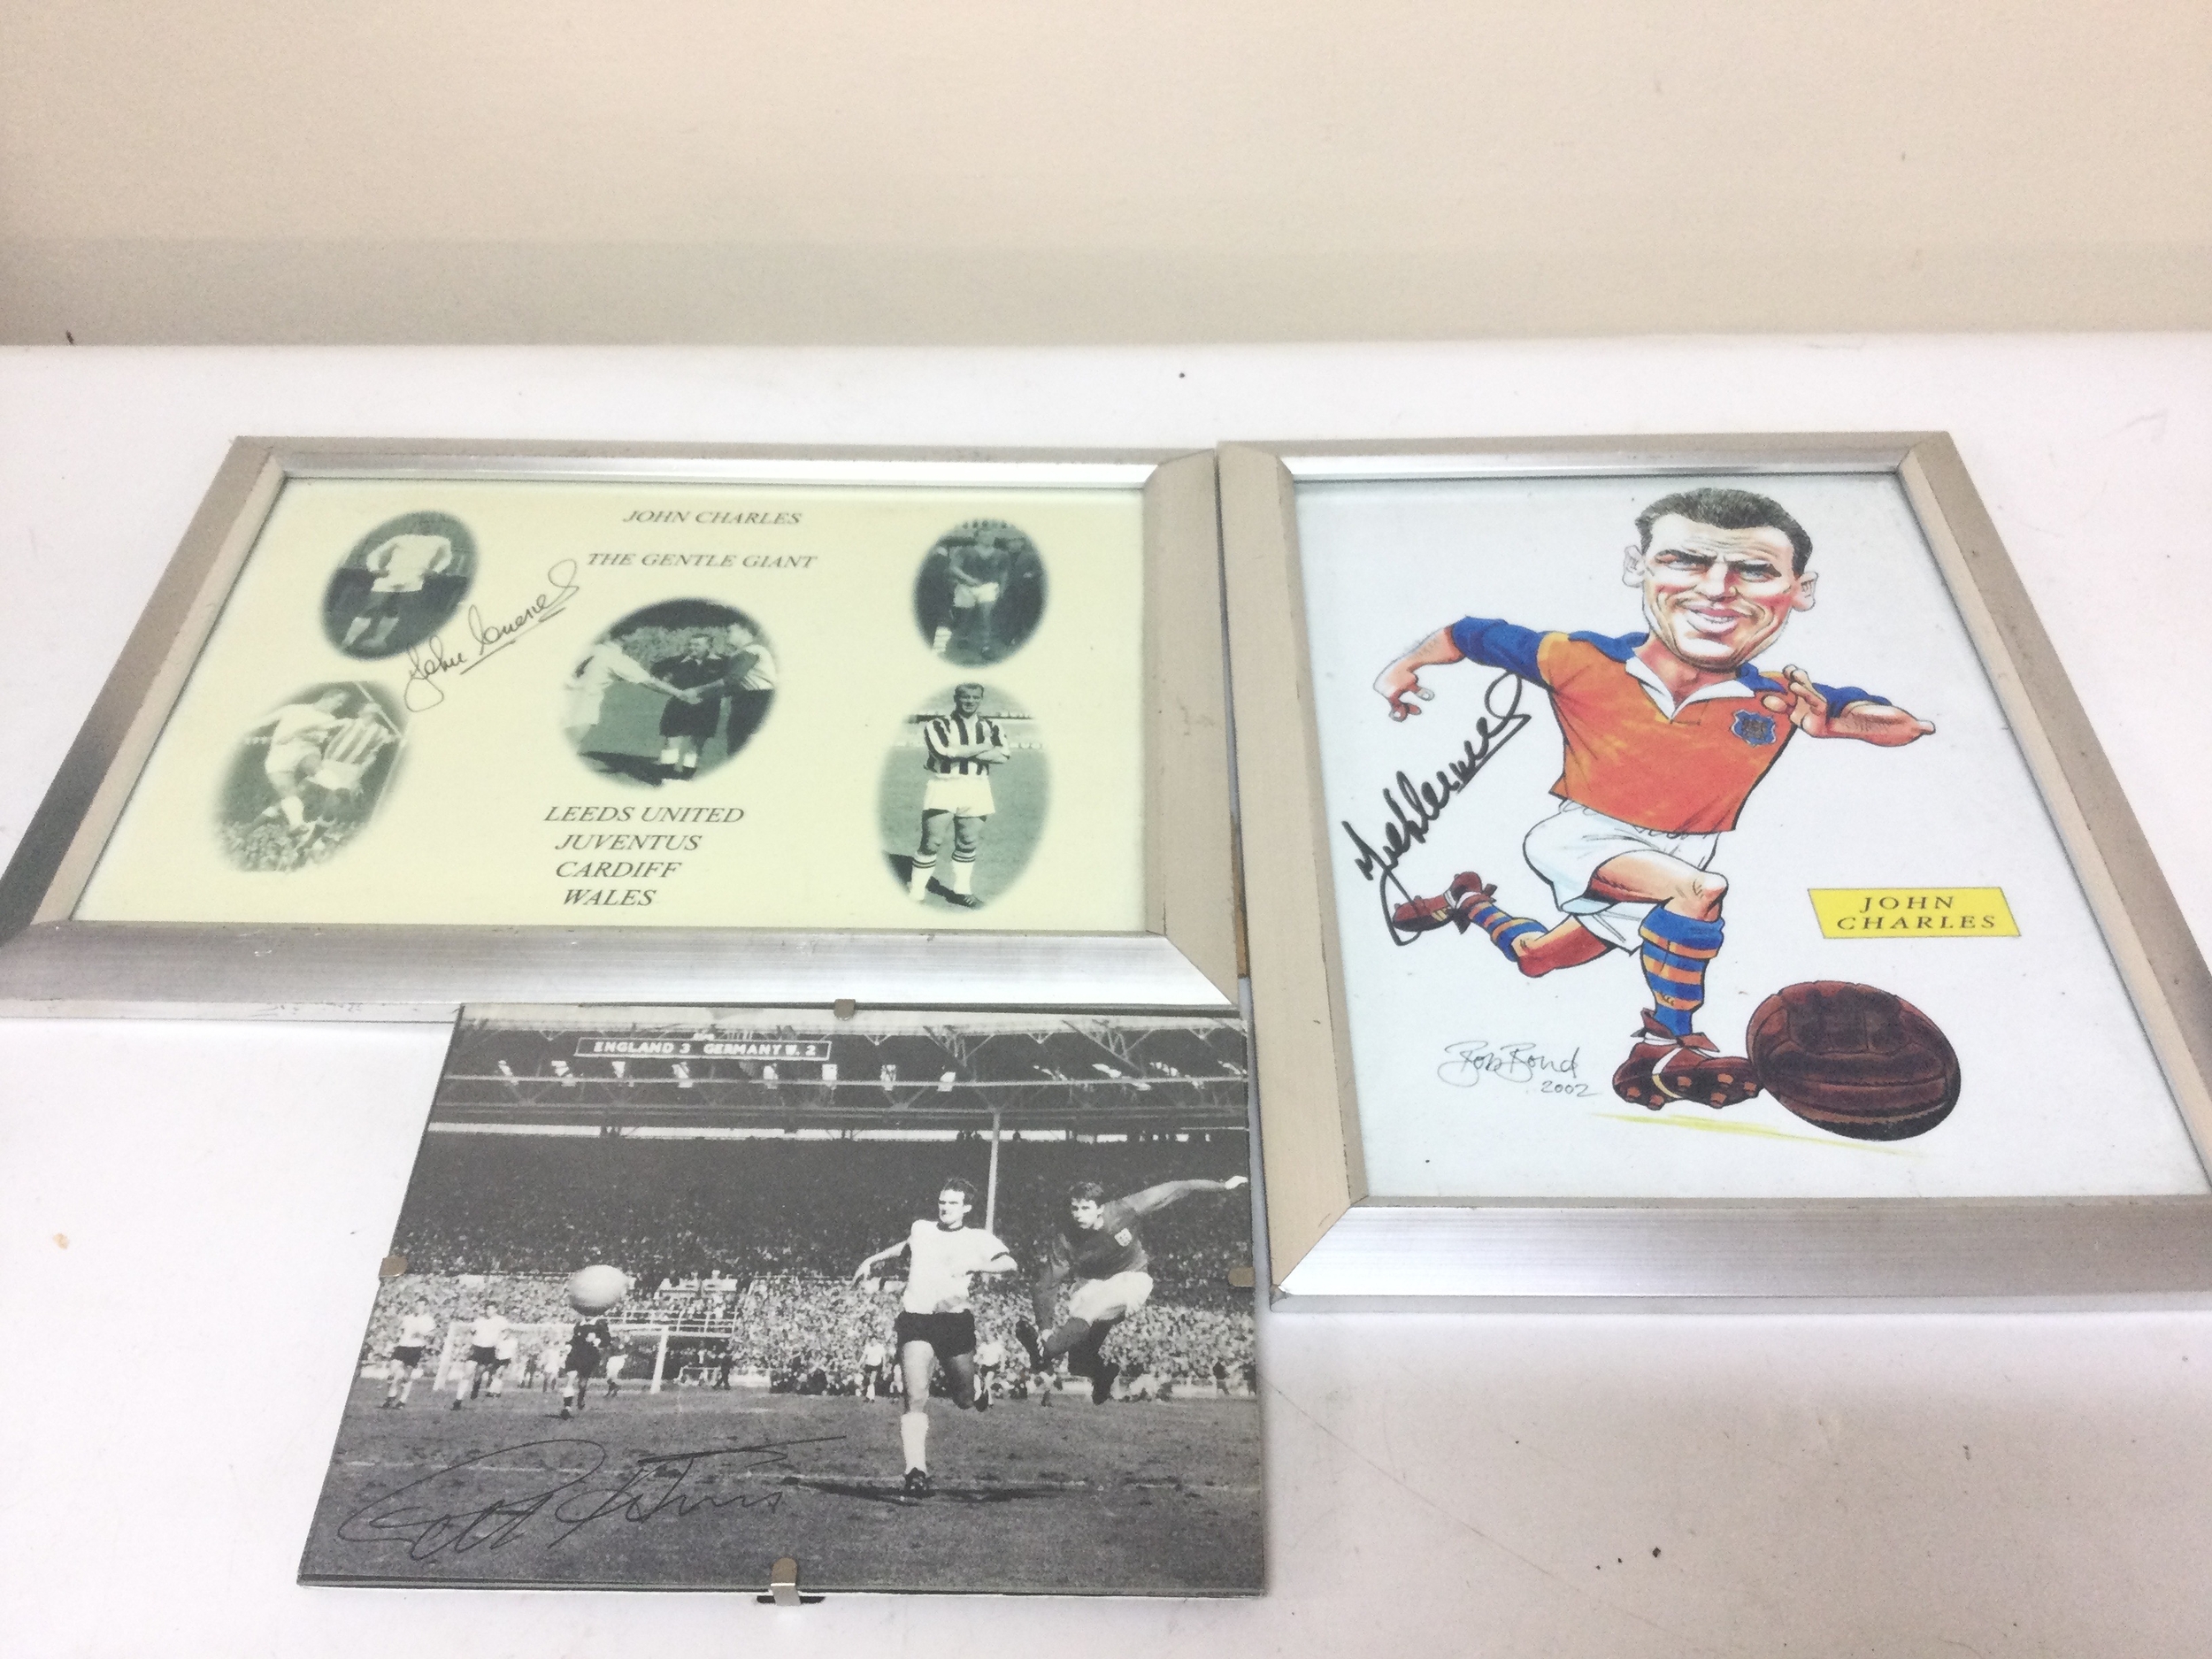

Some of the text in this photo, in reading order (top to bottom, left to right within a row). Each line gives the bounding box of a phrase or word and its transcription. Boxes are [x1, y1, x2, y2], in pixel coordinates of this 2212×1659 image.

[622, 511, 802, 525] JOHN CHARLES
[587, 553, 818, 570] THE GENTLE GIANT
[543, 806, 745, 823] LEEDS UNITED
[555, 834, 703, 851] JUVENTUS
[556, 861, 682, 878] CARDIFF
[563, 889, 657, 906] WALES
[1859, 896, 1954, 913] JOHN
[1837, 915, 1996, 930] CHARLES
[594, 1041, 674, 1054] ENGLAND
[679, 1042, 691, 1054] 3
[703, 1043, 781, 1056] GERMANY
[806, 1045, 817, 1056] 2
[1540, 1080, 1601, 1097] 2002
